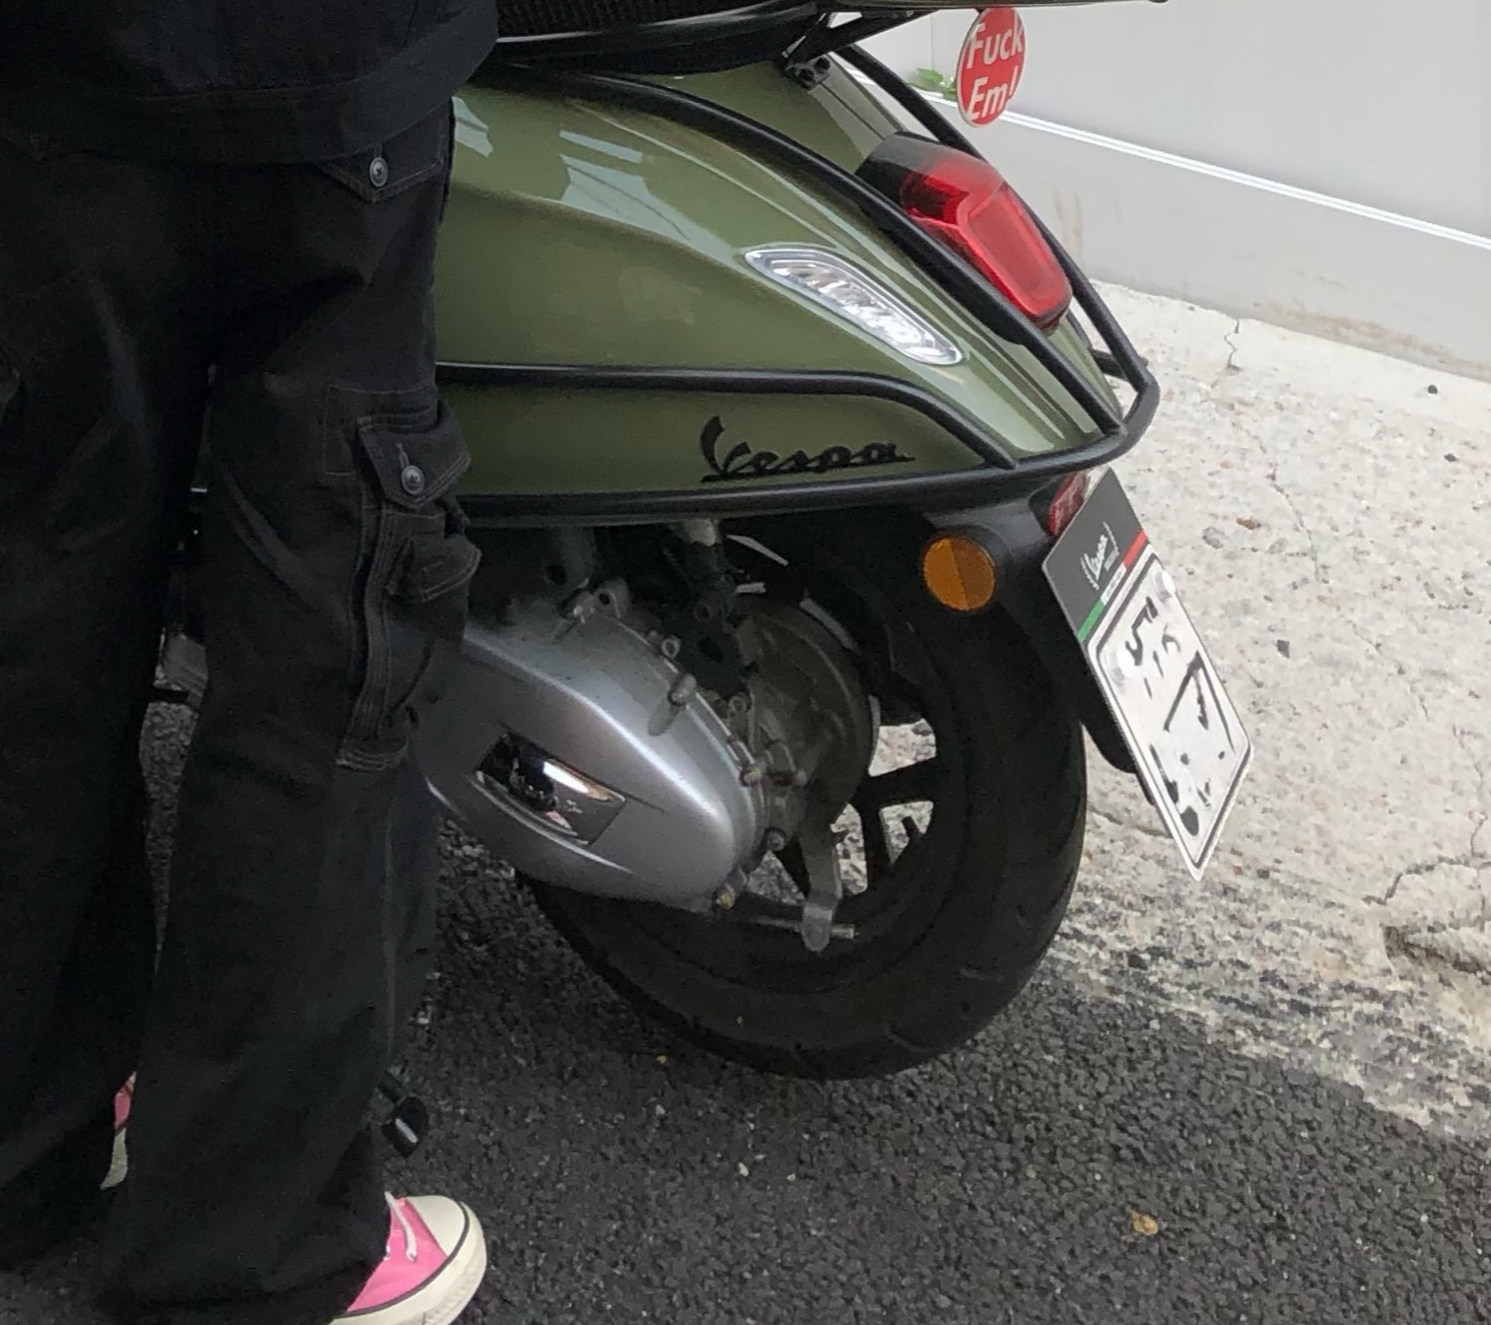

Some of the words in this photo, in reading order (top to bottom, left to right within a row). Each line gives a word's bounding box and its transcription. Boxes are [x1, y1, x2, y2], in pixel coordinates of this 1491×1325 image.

[965, 9, 1024, 69] Fuck
[966, 64, 1019, 121] Em!
[699, 415, 916, 483] Vespa
